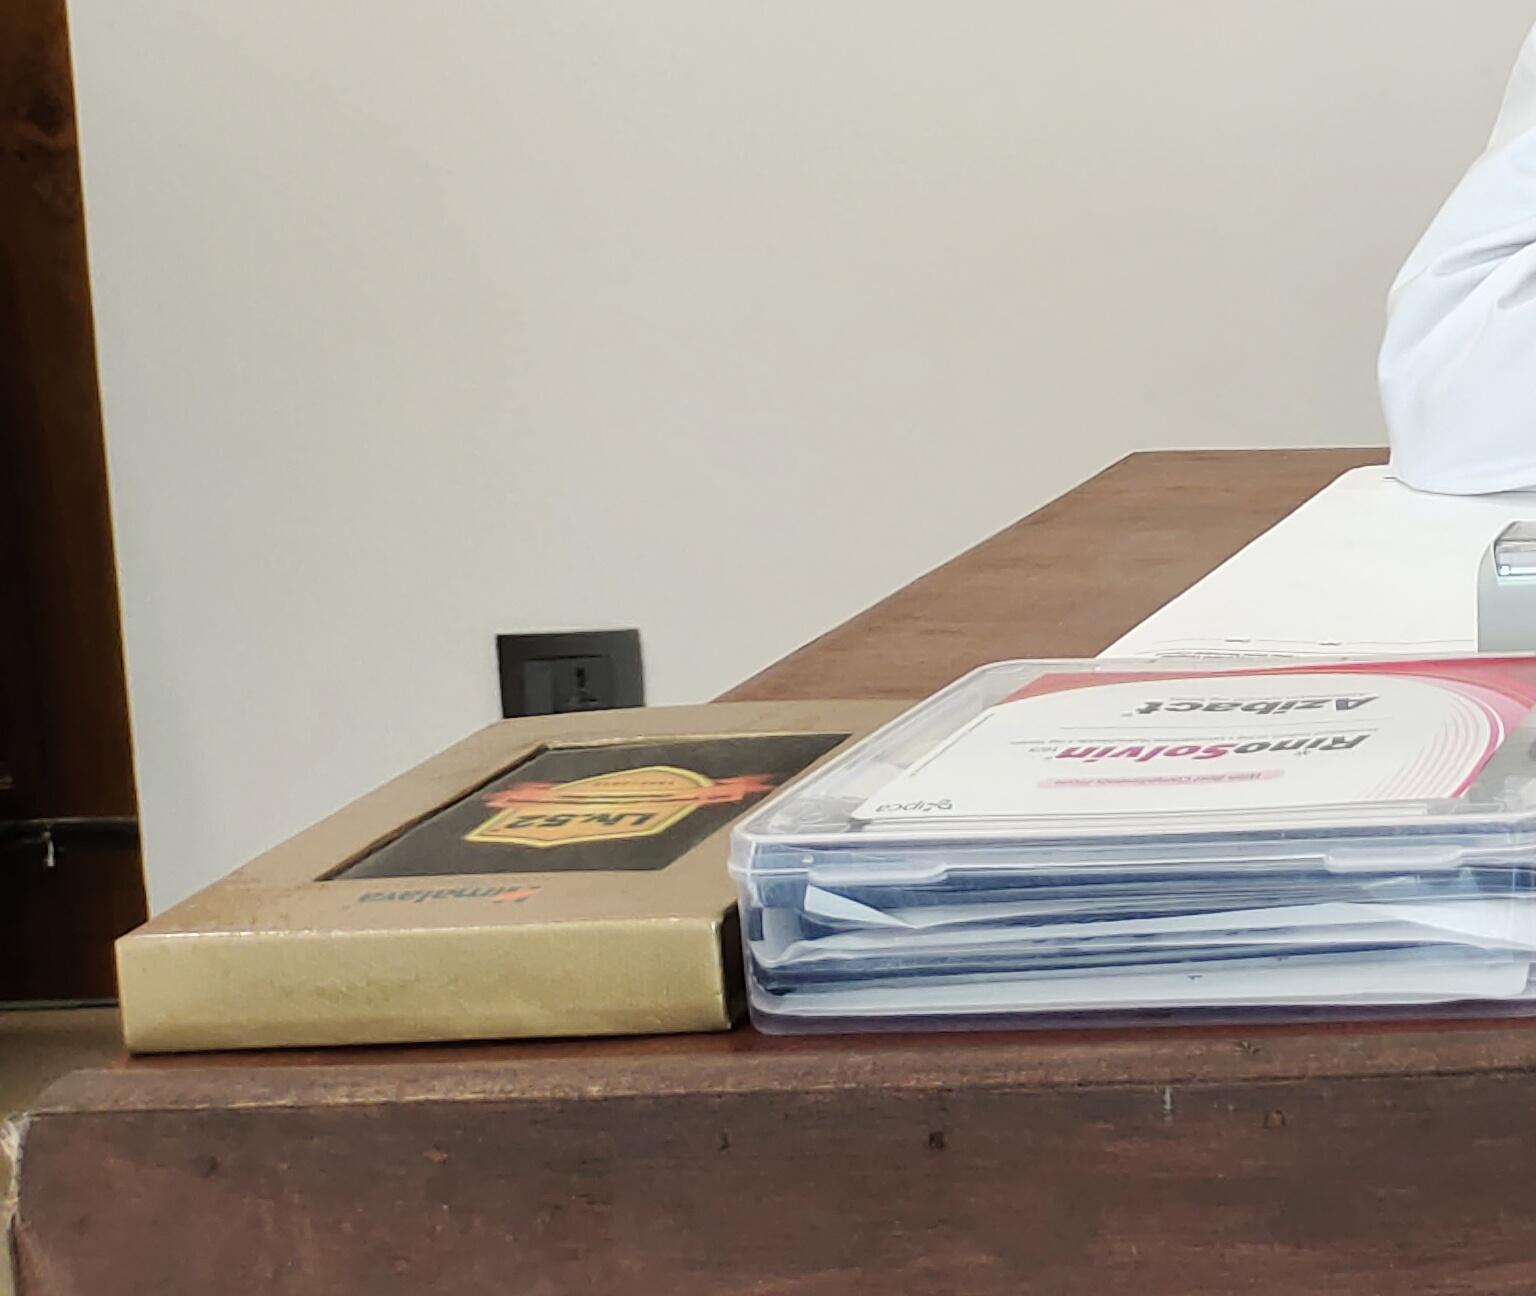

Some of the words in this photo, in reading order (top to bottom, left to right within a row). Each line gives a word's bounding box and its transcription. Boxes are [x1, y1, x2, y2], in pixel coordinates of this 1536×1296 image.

[1137, 694, 1380, 715] Azibact
[1056, 734, 1371, 762] RinoSolvin
[506, 812, 656, 829] Liv.52
